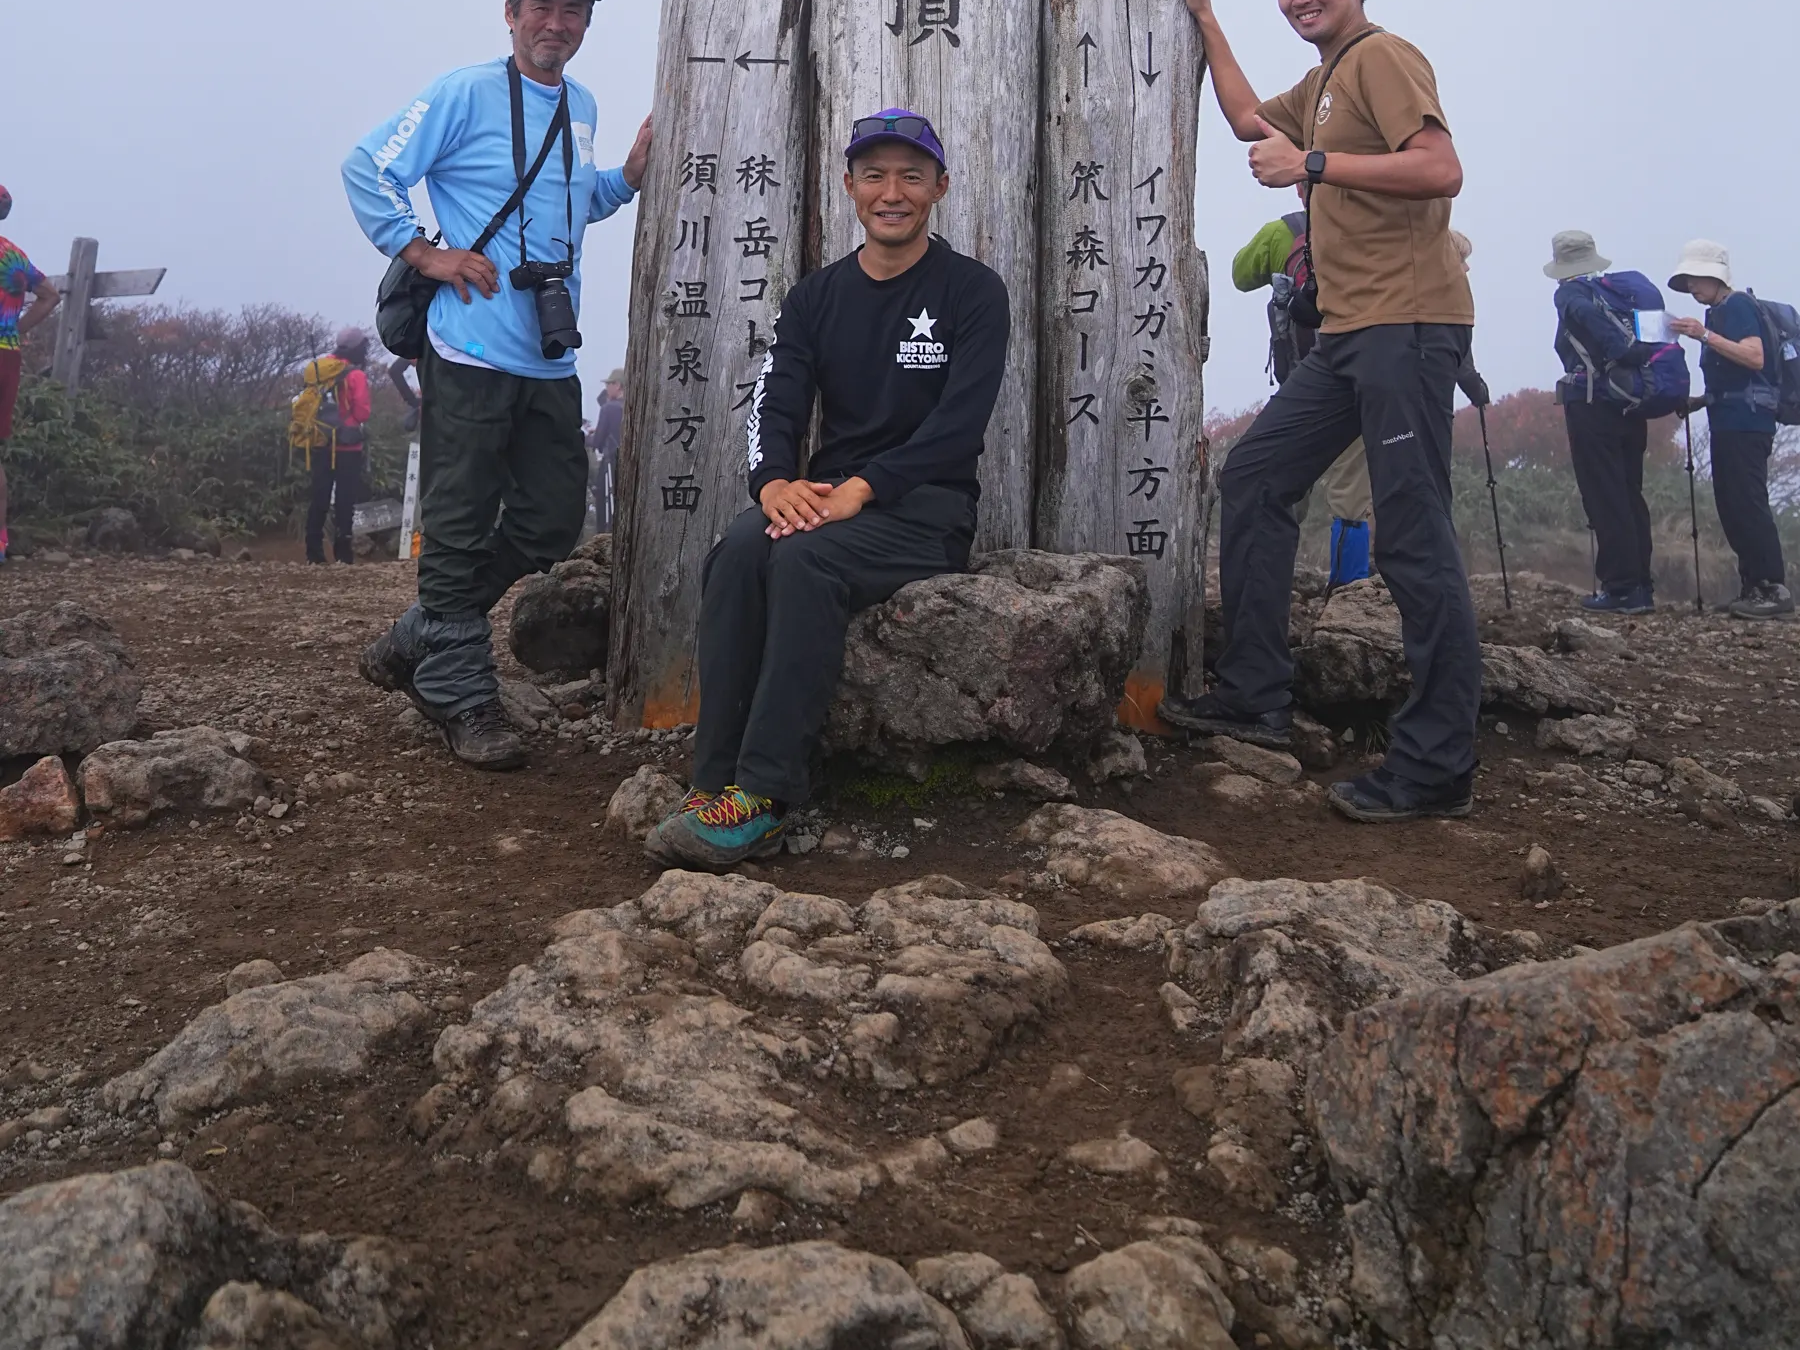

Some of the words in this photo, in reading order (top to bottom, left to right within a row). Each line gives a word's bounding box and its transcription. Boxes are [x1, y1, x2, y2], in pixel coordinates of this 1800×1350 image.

[660, 152, 718, 514] 須川温泉方面
[896, 353, 948, 363] KICCYOMU
[899, 341, 944, 353] BISTRO
[1066, 160, 1109, 426] 笊森コース
[1125, 166, 1173, 561] イワカガミ平方面
